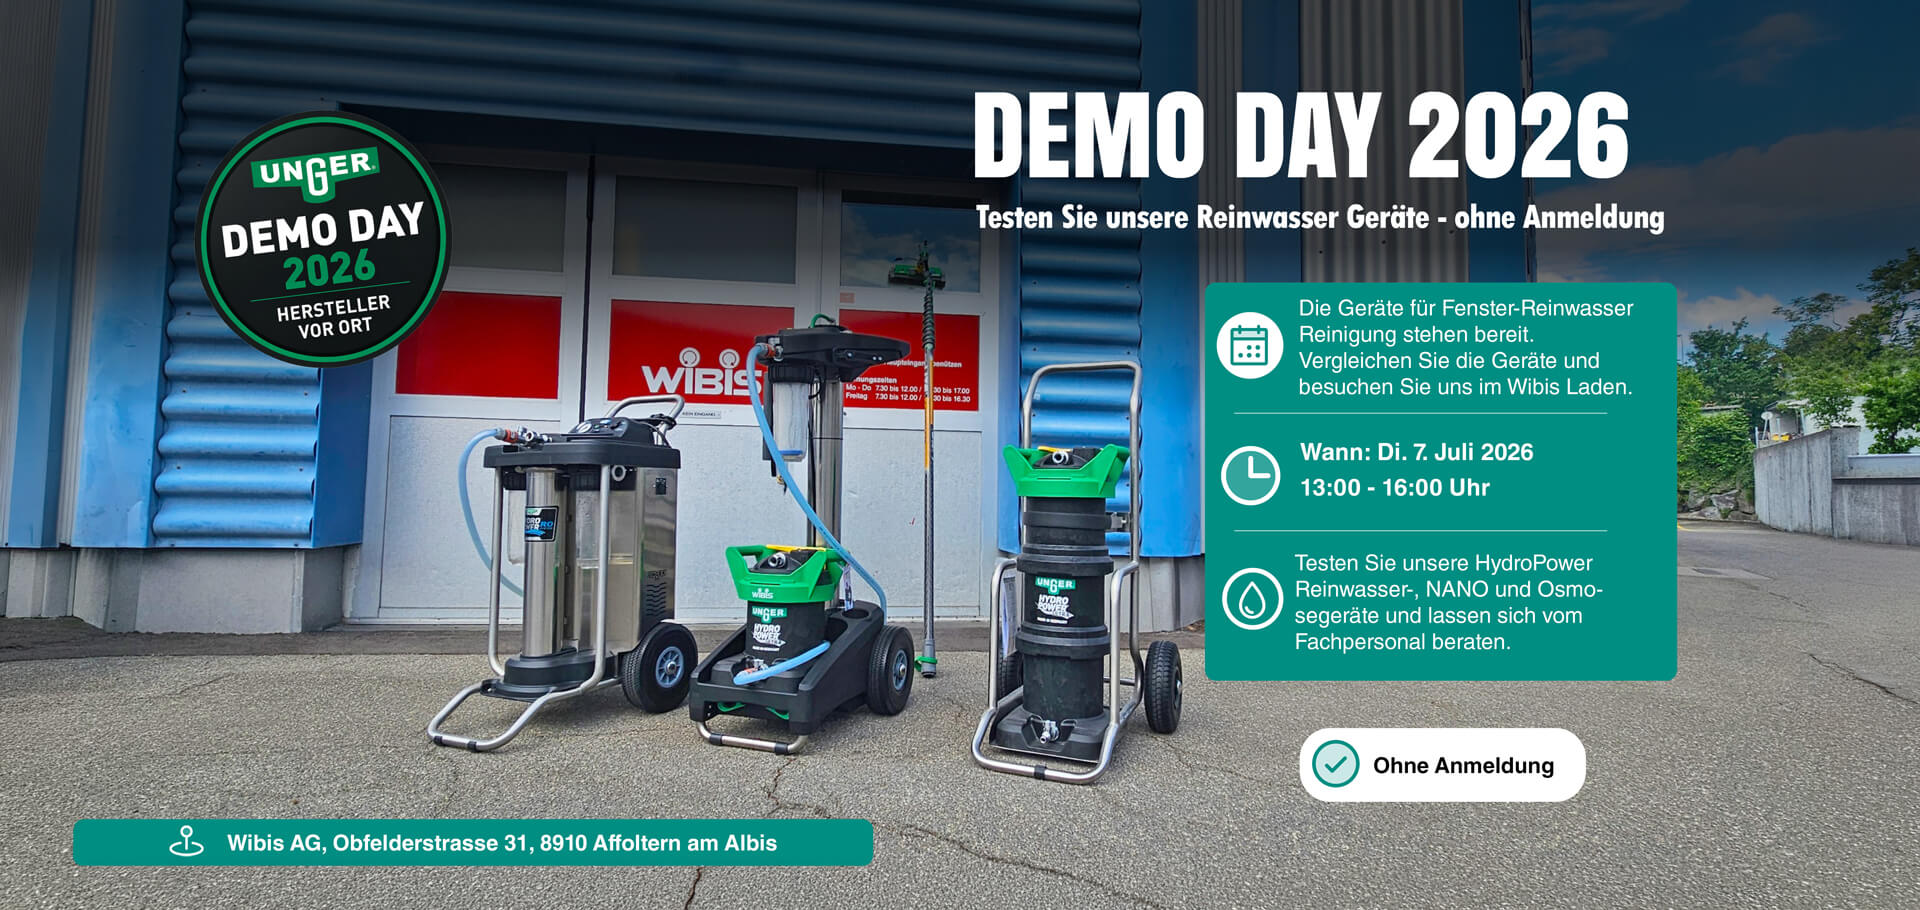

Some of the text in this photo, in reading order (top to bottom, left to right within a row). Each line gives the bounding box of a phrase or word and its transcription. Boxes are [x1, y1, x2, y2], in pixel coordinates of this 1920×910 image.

[641, 347, 762, 396] WIBIS
[845, 392, 868, 400] Freitag
[1037, 577, 1073, 593] UNGER
[1039, 594, 1069, 605] HYDRO
[1038, 602, 1069, 612] POWER
[752, 607, 784, 621] UNGER
[754, 623, 781, 633] HYDRO
[753, 631, 781, 641] POWER
